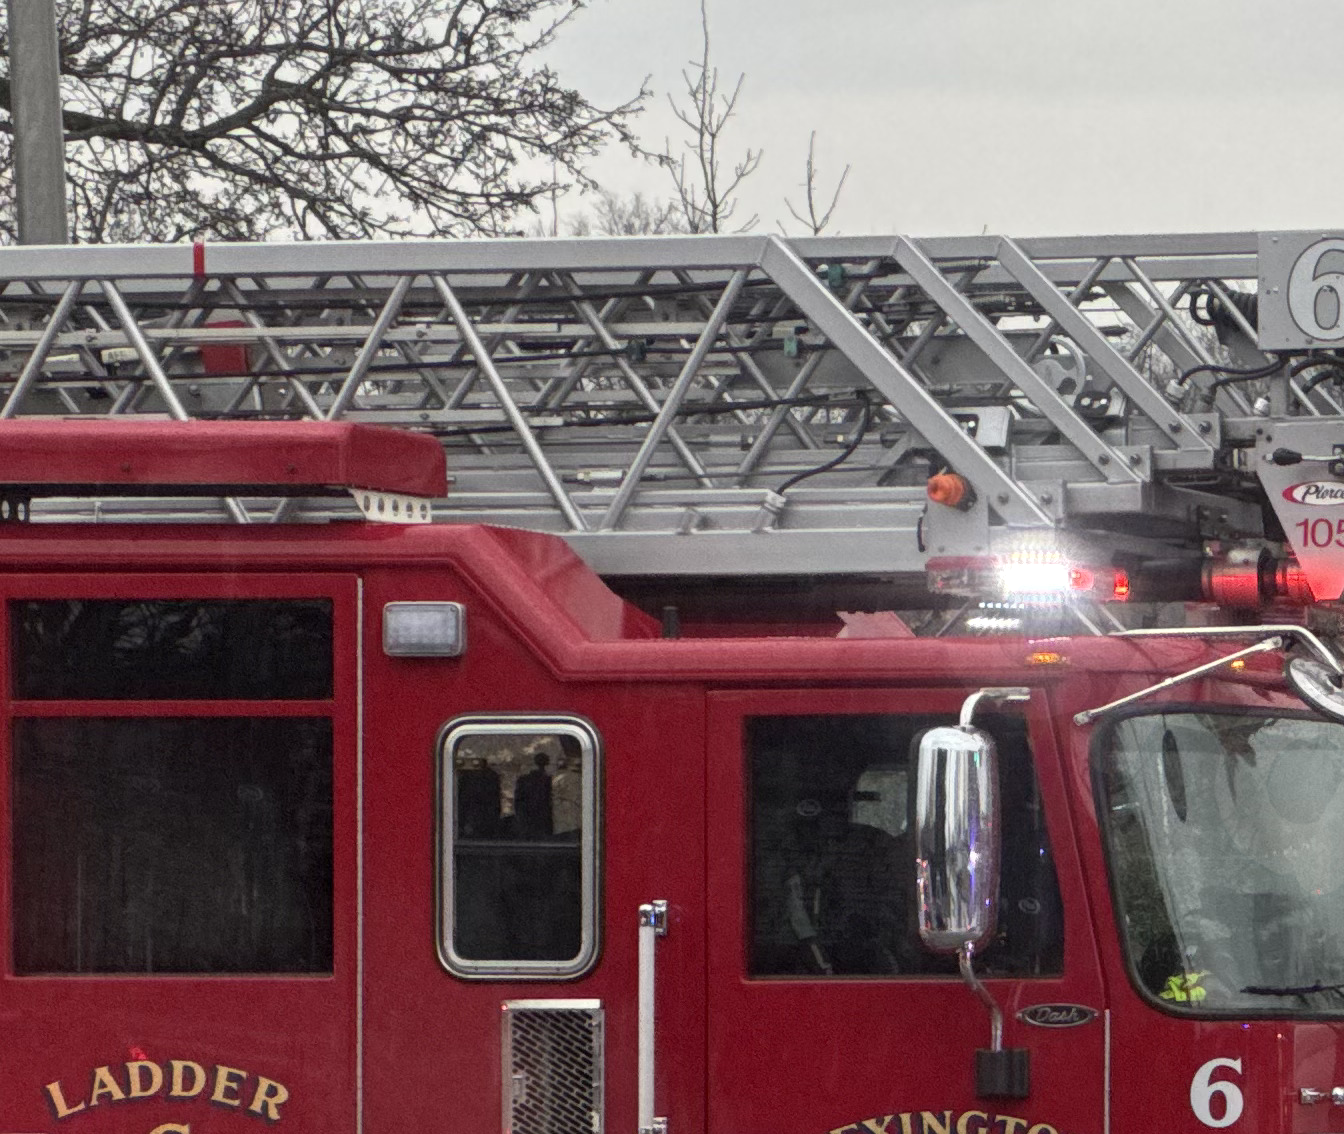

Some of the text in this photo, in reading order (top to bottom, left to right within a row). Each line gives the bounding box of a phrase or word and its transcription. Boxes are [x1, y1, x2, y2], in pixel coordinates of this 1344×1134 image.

[1035, 1006, 1079, 1023] Dash
[44, 1058, 291, 1122] LADDER
[1190, 1057, 1244, 1128] 6
